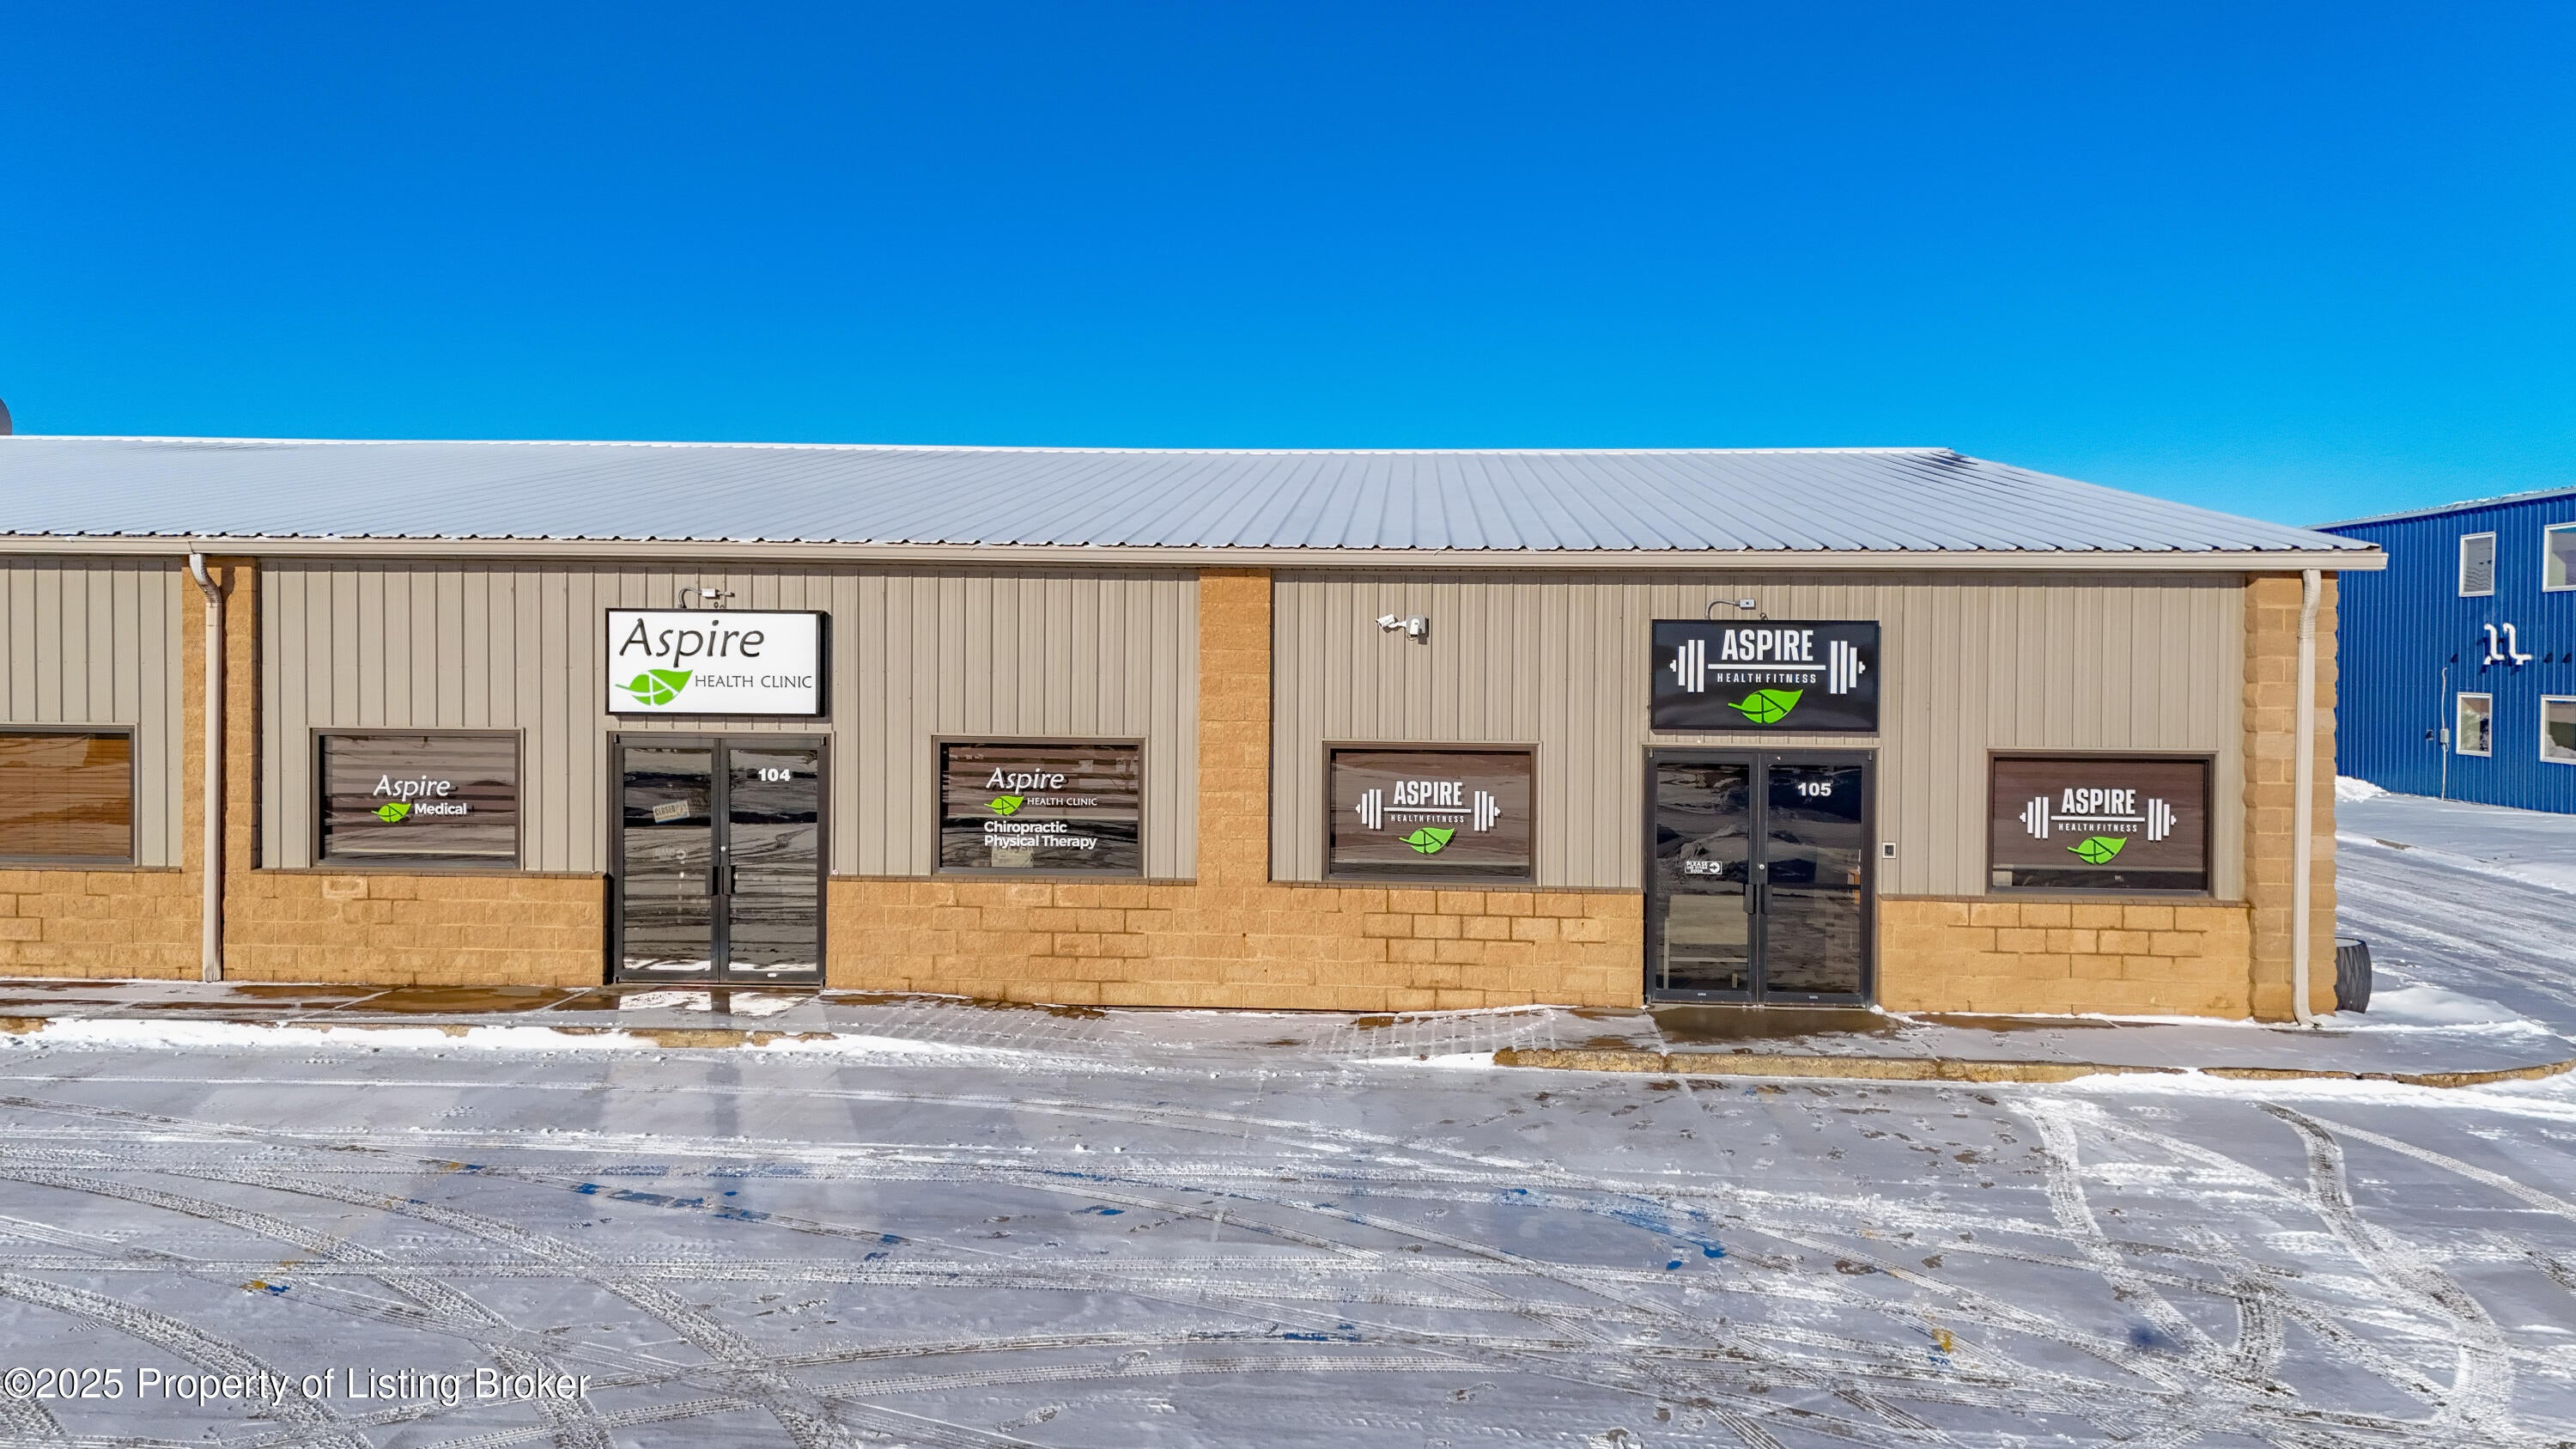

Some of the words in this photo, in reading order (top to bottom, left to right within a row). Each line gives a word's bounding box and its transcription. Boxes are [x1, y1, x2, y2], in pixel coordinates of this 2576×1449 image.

[619, 618, 765, 668] Aspire
[1721, 629, 1814, 661] ASPIRE
[695, 675, 753, 688] HEALTH
[761, 675, 812, 688] CLINIC
[1716, 673, 1761, 683] HEALTH
[1765, 673, 1817, 684] FITNESS
[758, 768, 791, 782] 104
[986, 767, 1065, 795] Aspire
[373, 774, 451, 802] Aspire
[1393, 780, 1463, 806] ASPIRE
[1797, 782, 1832, 796] 105
[1027, 797, 1063, 806] HEALTH
[1066, 797, 1098, 807] CLINIC
[2061, 788, 2136, 814] ASPIRE
[415, 802, 467, 815] Medical
[1426, 815, 1465, 824] FITNESS
[983, 820, 1068, 836] Chiropractic
[2058, 823, 2096, 831] HEALTH
[2097, 823, 2137, 832] FITNESS
[984, 834, 1040, 849] Physical
[1042, 836, 1098, 849] Therapy
